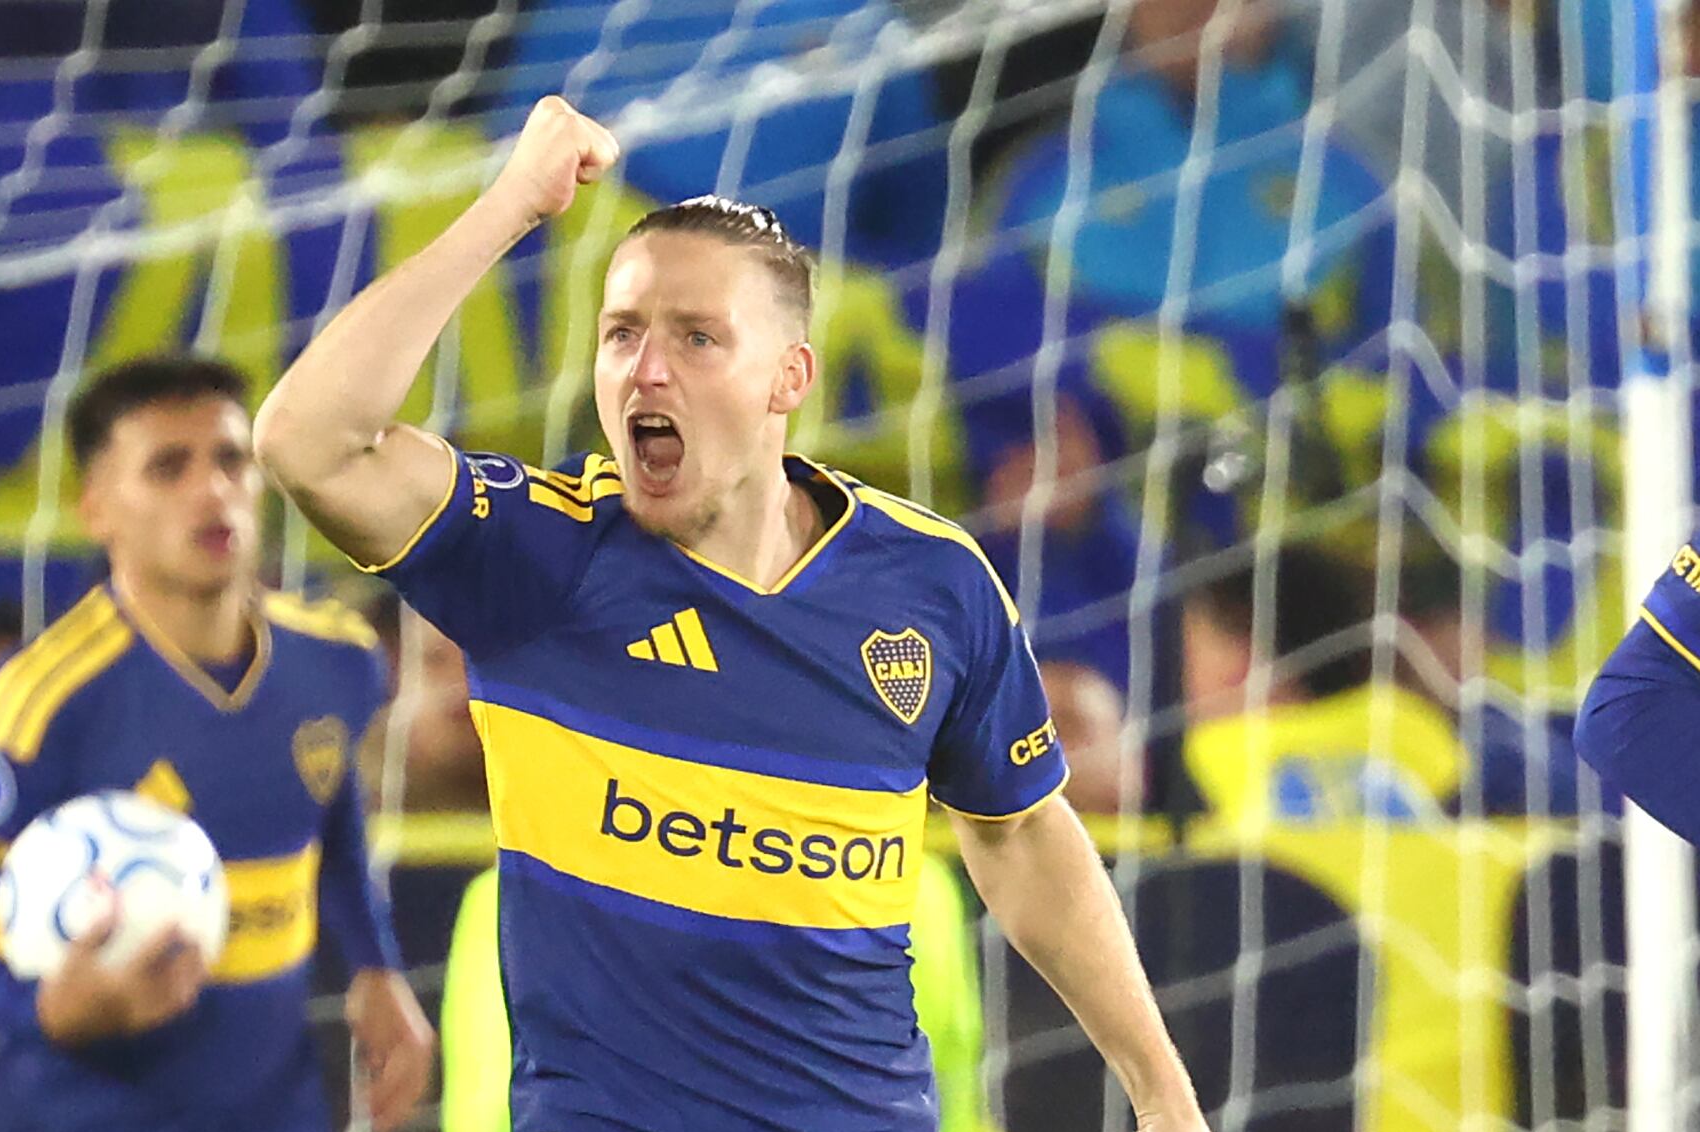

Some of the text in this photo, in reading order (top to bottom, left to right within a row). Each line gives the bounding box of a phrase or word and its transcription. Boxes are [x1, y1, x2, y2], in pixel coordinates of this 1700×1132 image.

[875, 660, 925, 681] CABJ
[1009, 716, 1057, 766] CET
[600, 778, 905, 881] betsson
